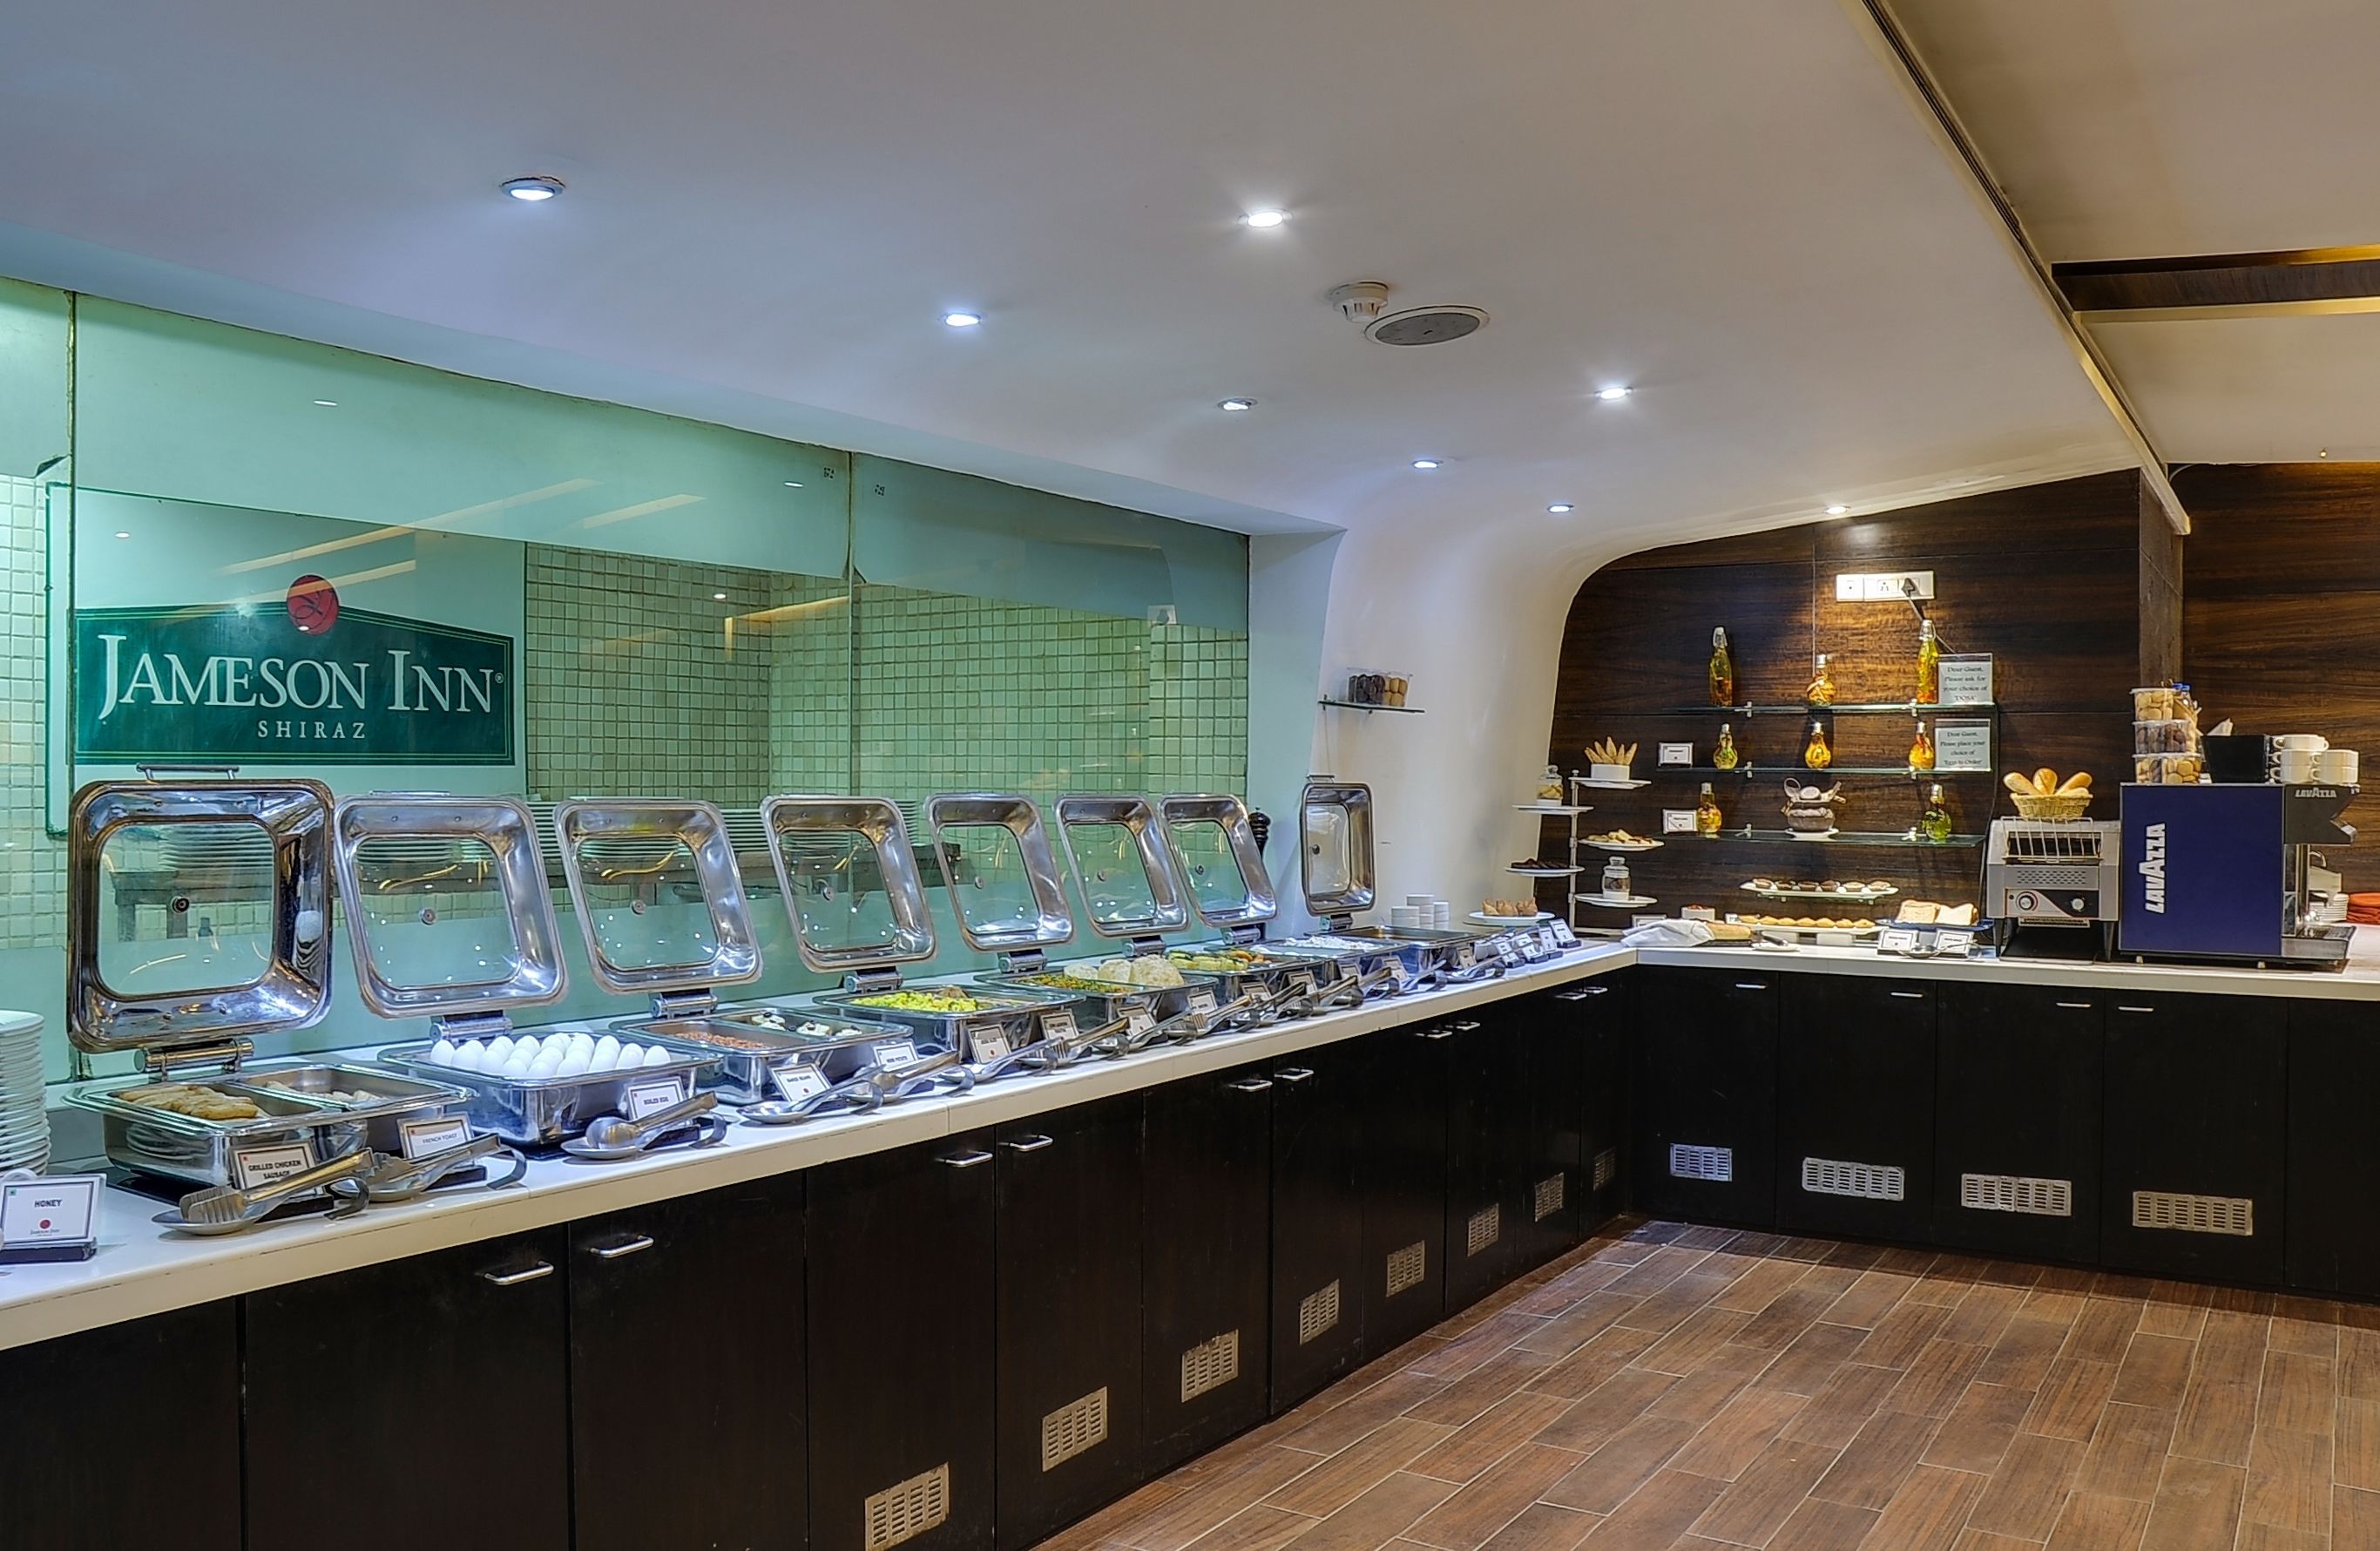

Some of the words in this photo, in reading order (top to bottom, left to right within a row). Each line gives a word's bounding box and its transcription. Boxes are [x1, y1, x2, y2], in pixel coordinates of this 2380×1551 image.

[97, 633, 371, 721] JAMESON
[257, 720, 366, 739] SHIRAZ
[2295, 787, 2337, 798] LAVAZZA
[2139, 823, 2166, 914] LAVAZZA
[247, 1162, 274, 1172] GRILLED
[274, 1159, 302, 1168] CHICKEN
[34, 1198, 63, 1209] HONEY
